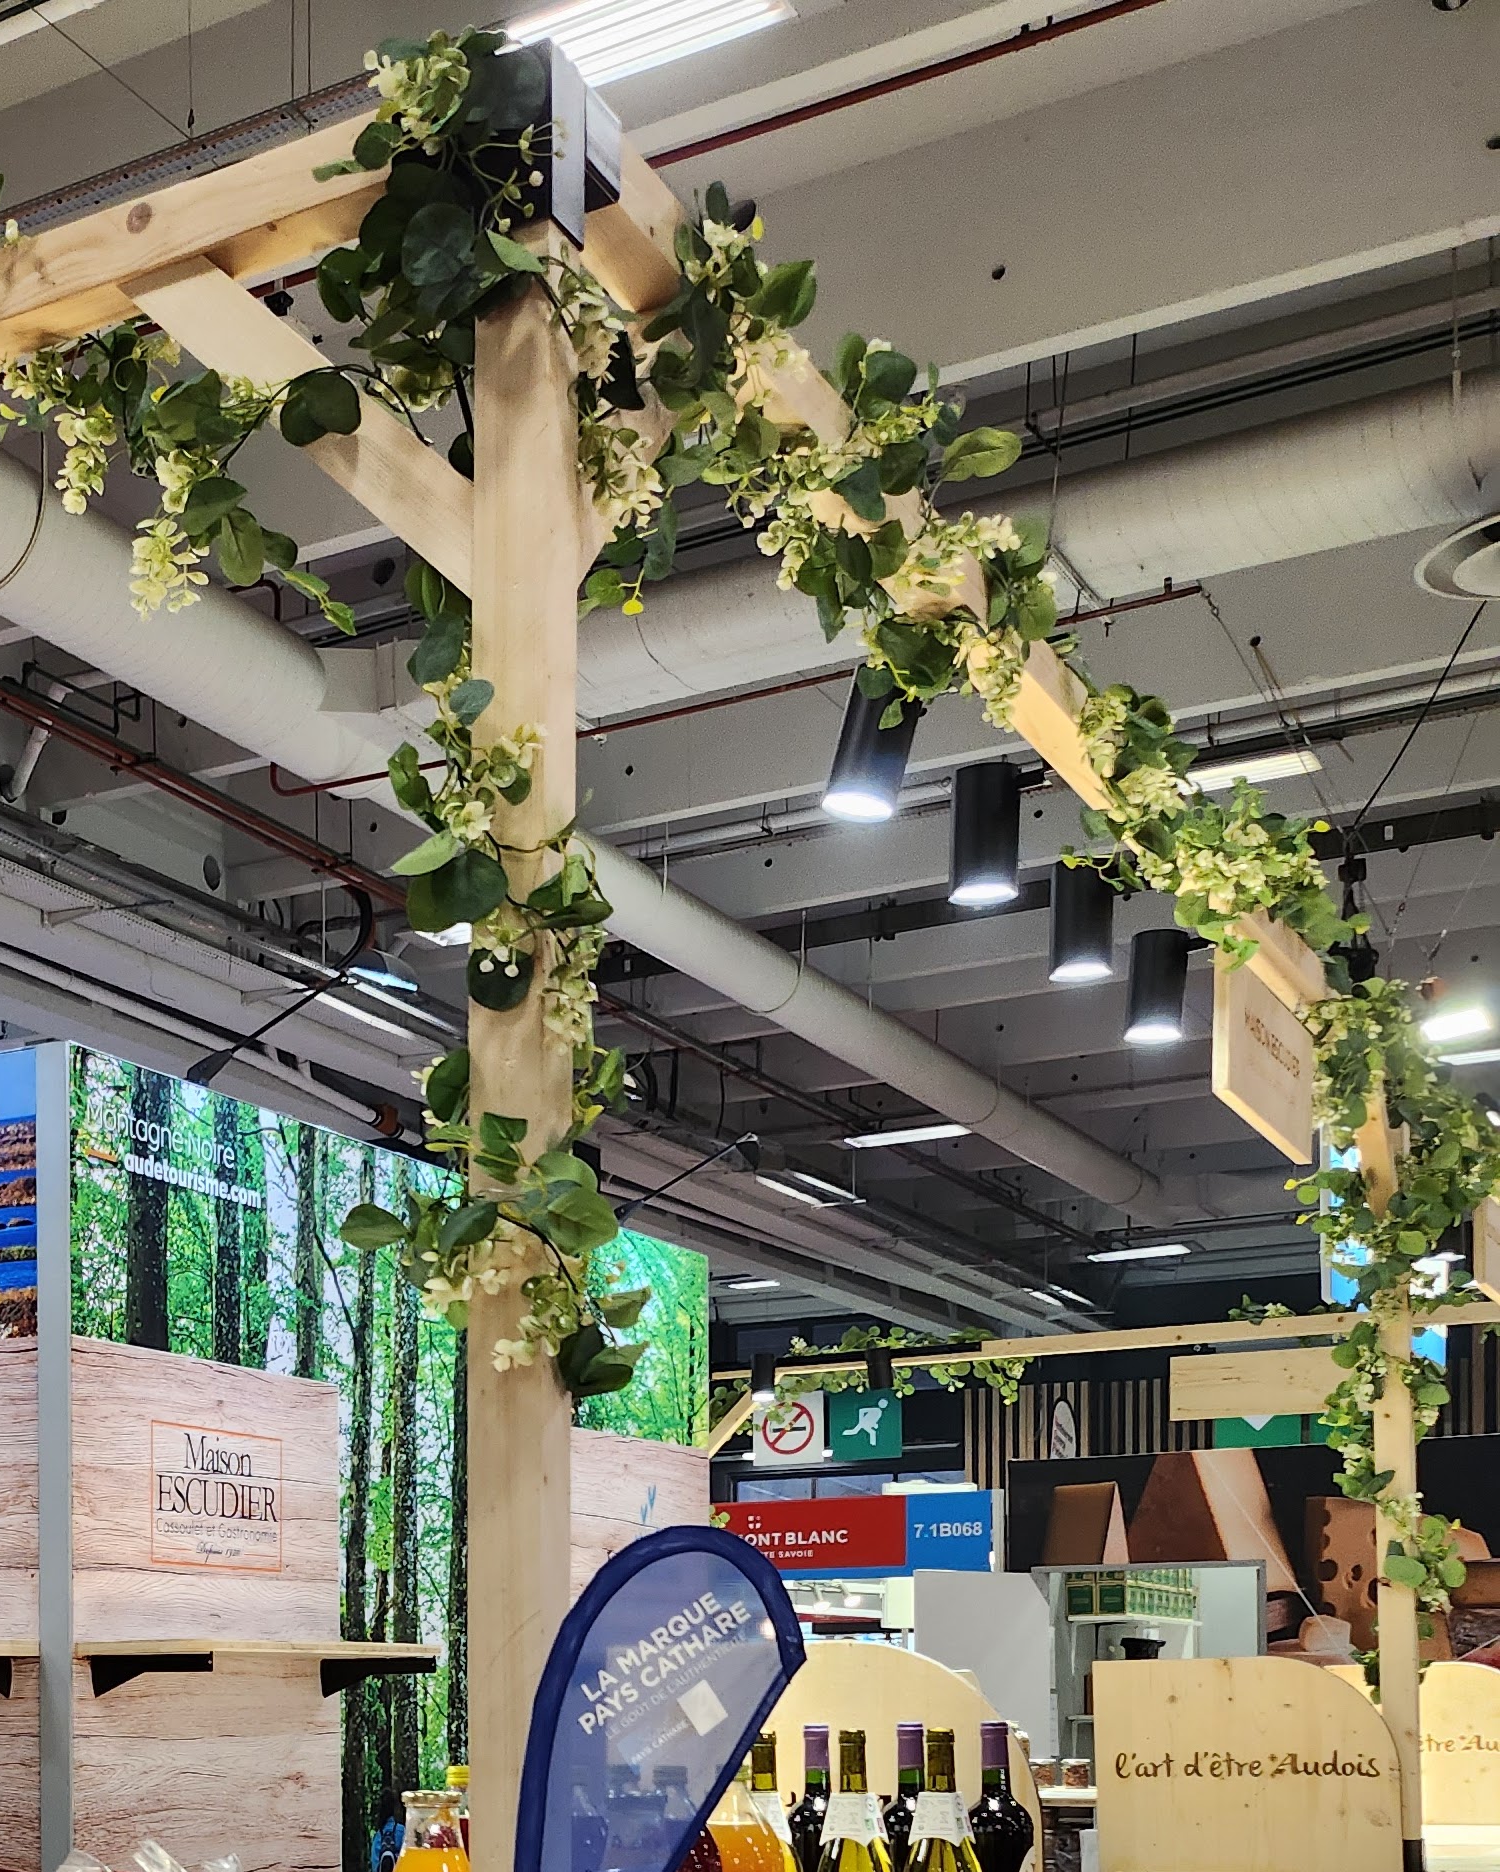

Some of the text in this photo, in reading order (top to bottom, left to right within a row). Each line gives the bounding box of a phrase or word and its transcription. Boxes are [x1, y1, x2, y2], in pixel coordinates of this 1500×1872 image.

[87, 1096, 235, 1169] Montagne Noire
[124, 1152, 262, 1208] audetourisme.com
[184, 1432, 251, 1477] Maison
[156, 1474, 279, 1523] ESCUDIER
[785, 1529, 849, 1546] BLANC
[913, 1521, 983, 1538] 7.1B068
[778, 1549, 814, 1559] SAVOIE
[577, 1600, 752, 1736] PAYS CATHARE
[580, 1591, 722, 1703] LA MARQUE
[1115, 1750, 1380, 1779] l'art d'être Audois
